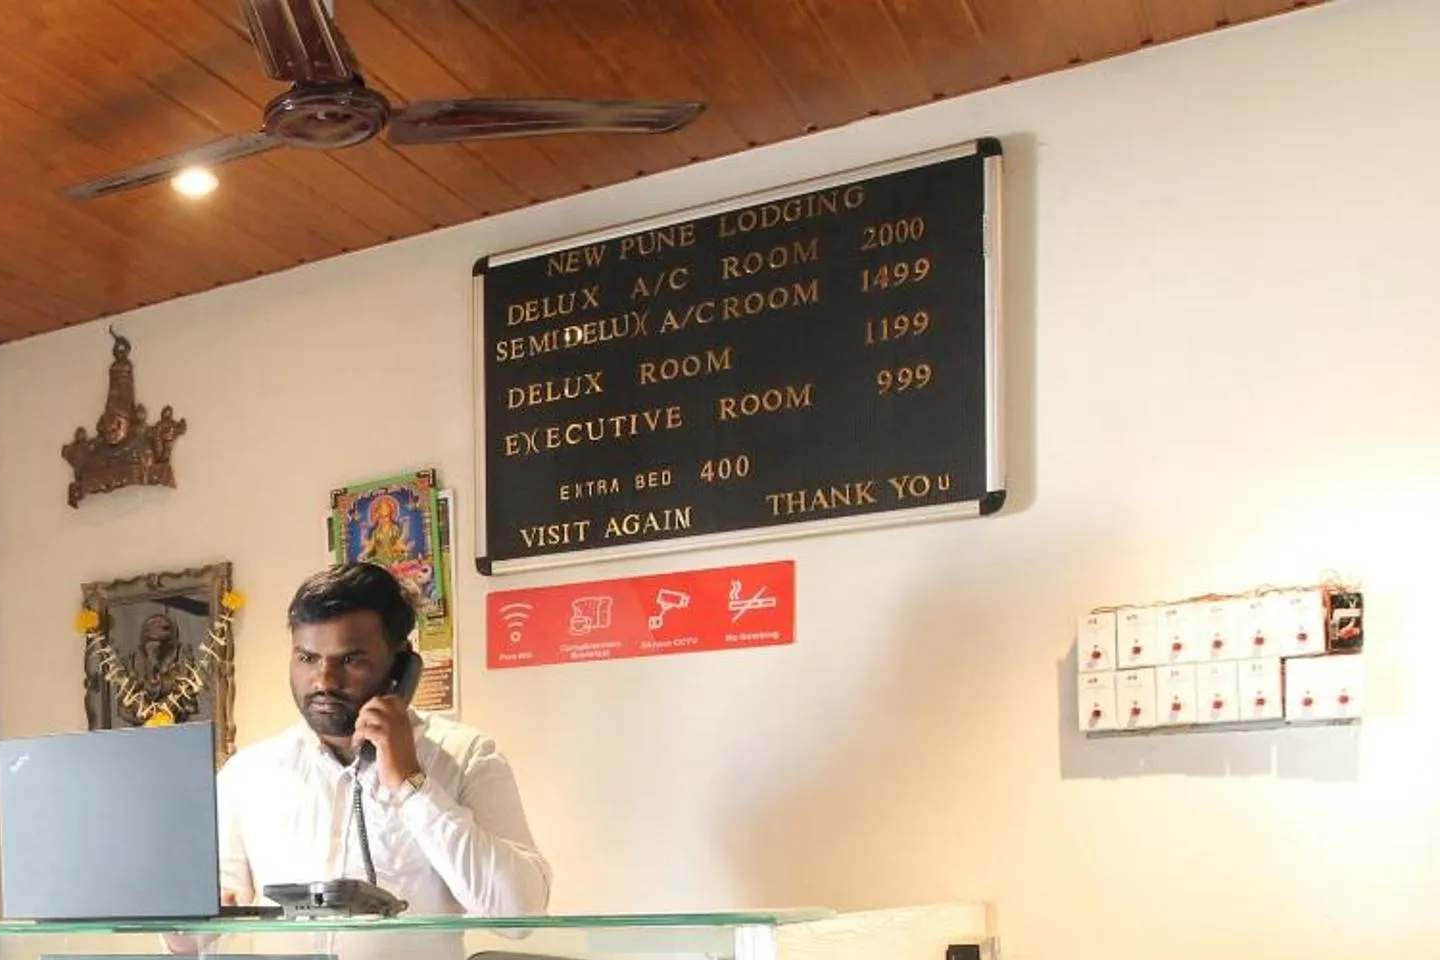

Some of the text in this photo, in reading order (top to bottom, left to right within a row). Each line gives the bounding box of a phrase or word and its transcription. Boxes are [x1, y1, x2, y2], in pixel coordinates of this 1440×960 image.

[507, 217, 925, 326] DELUX A/C ROOM 2000
[546, 185, 865, 277] NEW PUNE LODGING
[660, 302, 715, 334] A/C
[722, 279, 819, 320] ROOM
[861, 257, 931, 293] 1499
[508, 311, 929, 409] DELUX ROOM 1199
[505, 363, 932, 456] EXECUTIVE ROOM 999
[520, 520, 590, 548] VISIT
[604, 506, 692, 539] AGAIN
[766, 480, 877, 516] THANK
[560, 455, 750, 501] EXTRA BED 400
